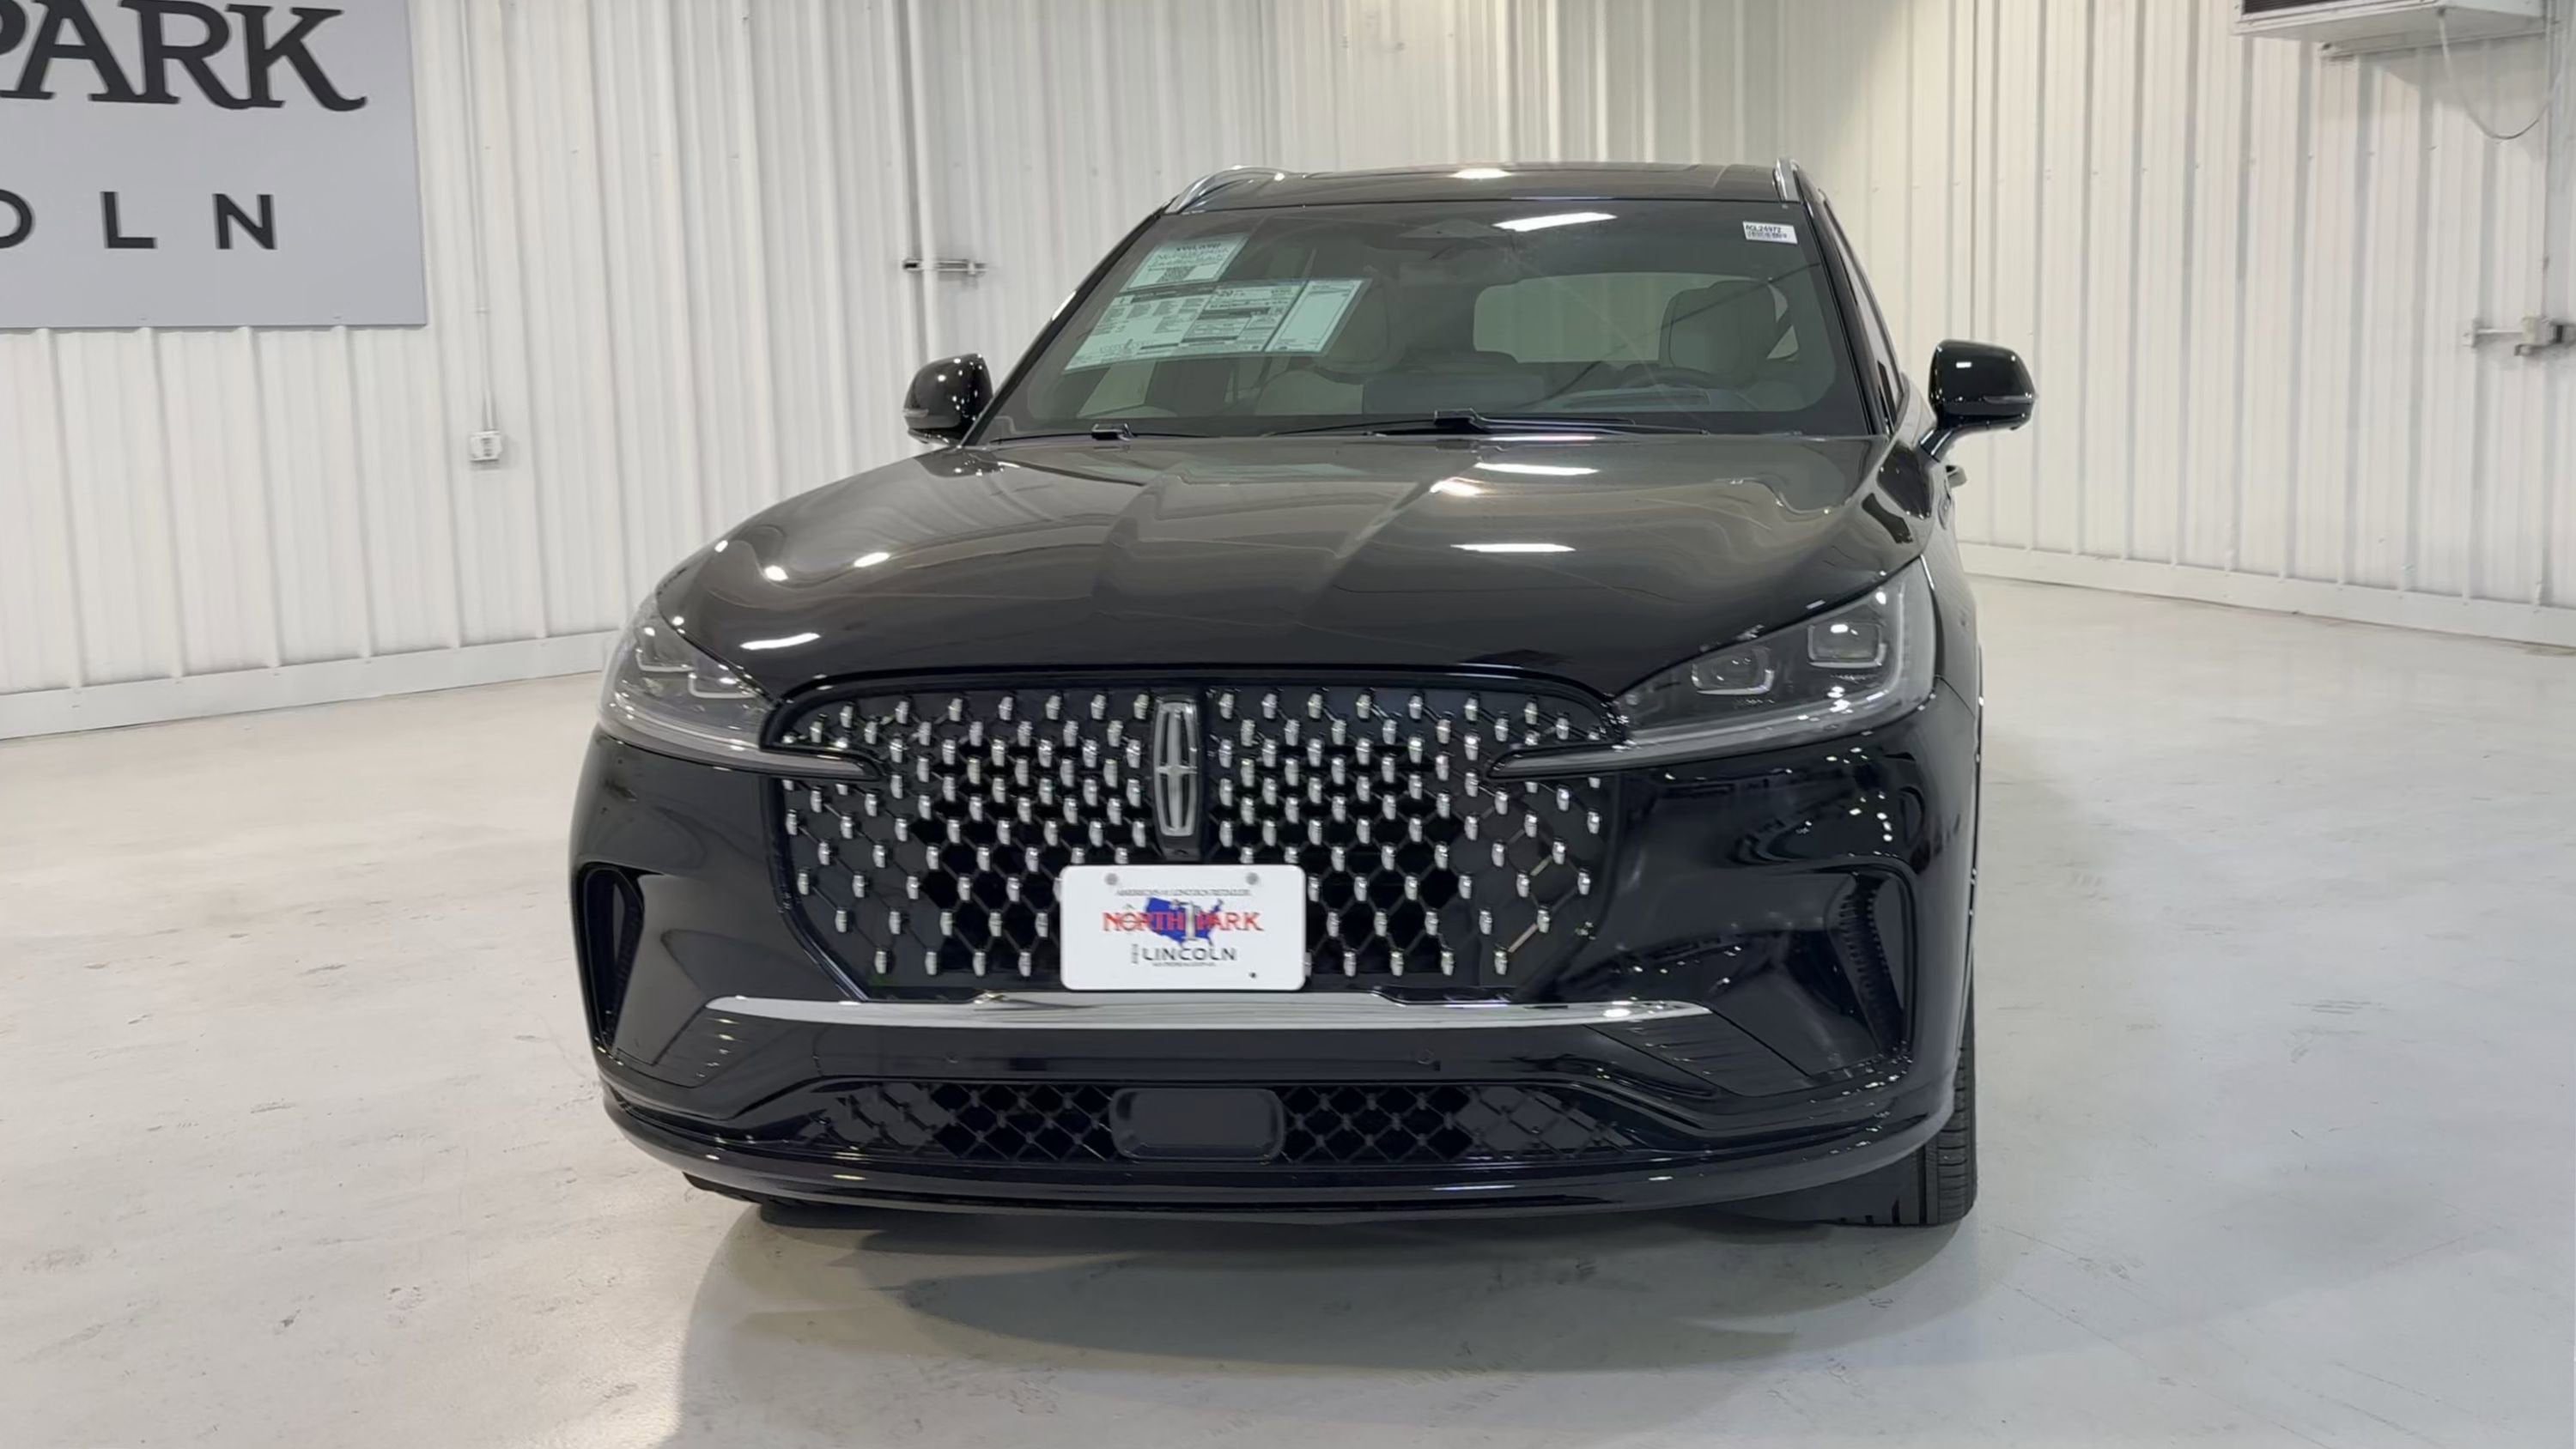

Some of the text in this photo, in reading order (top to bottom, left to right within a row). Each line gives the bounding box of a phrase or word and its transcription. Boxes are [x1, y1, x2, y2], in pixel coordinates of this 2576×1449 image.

[1103, 912, 1185, 931] NORTH
[1196, 911, 1264, 931] PARK
[1142, 948, 1237, 961] LINCOLN
